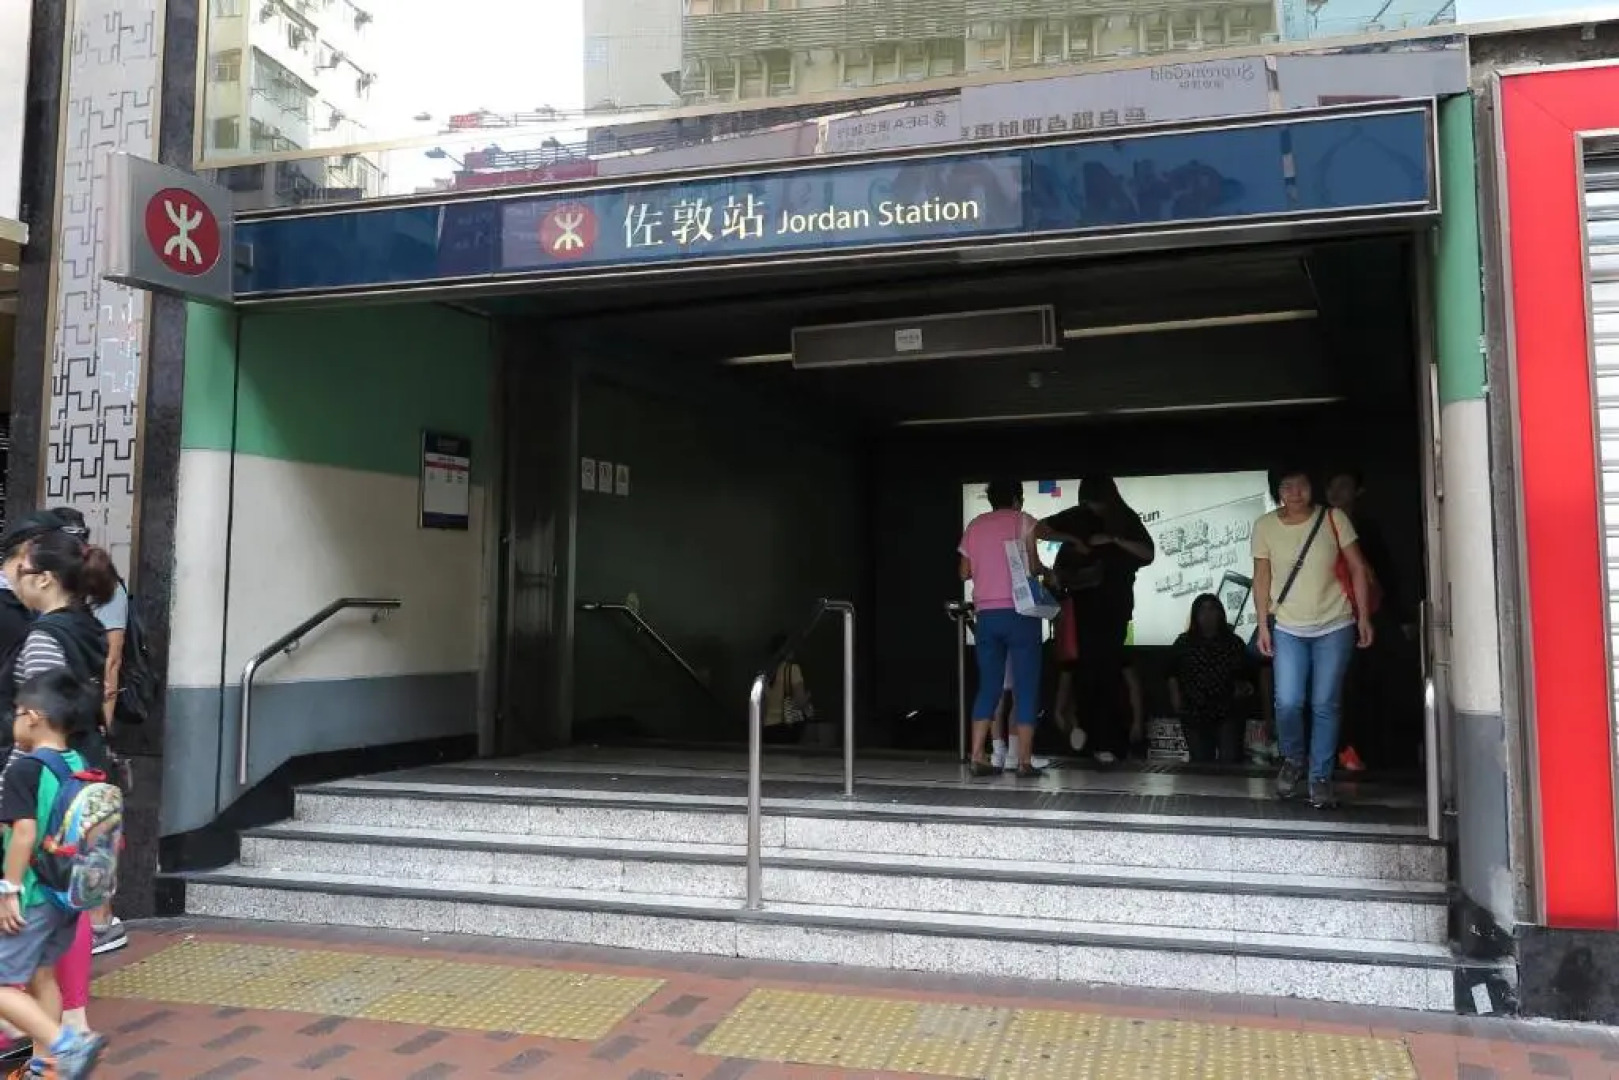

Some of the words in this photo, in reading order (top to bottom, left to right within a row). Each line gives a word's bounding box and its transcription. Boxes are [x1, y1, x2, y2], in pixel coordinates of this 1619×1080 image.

[623, 195, 764, 249] 佐敦站
[777, 206, 869, 236] Jordan
[878, 193, 978, 227] Station
